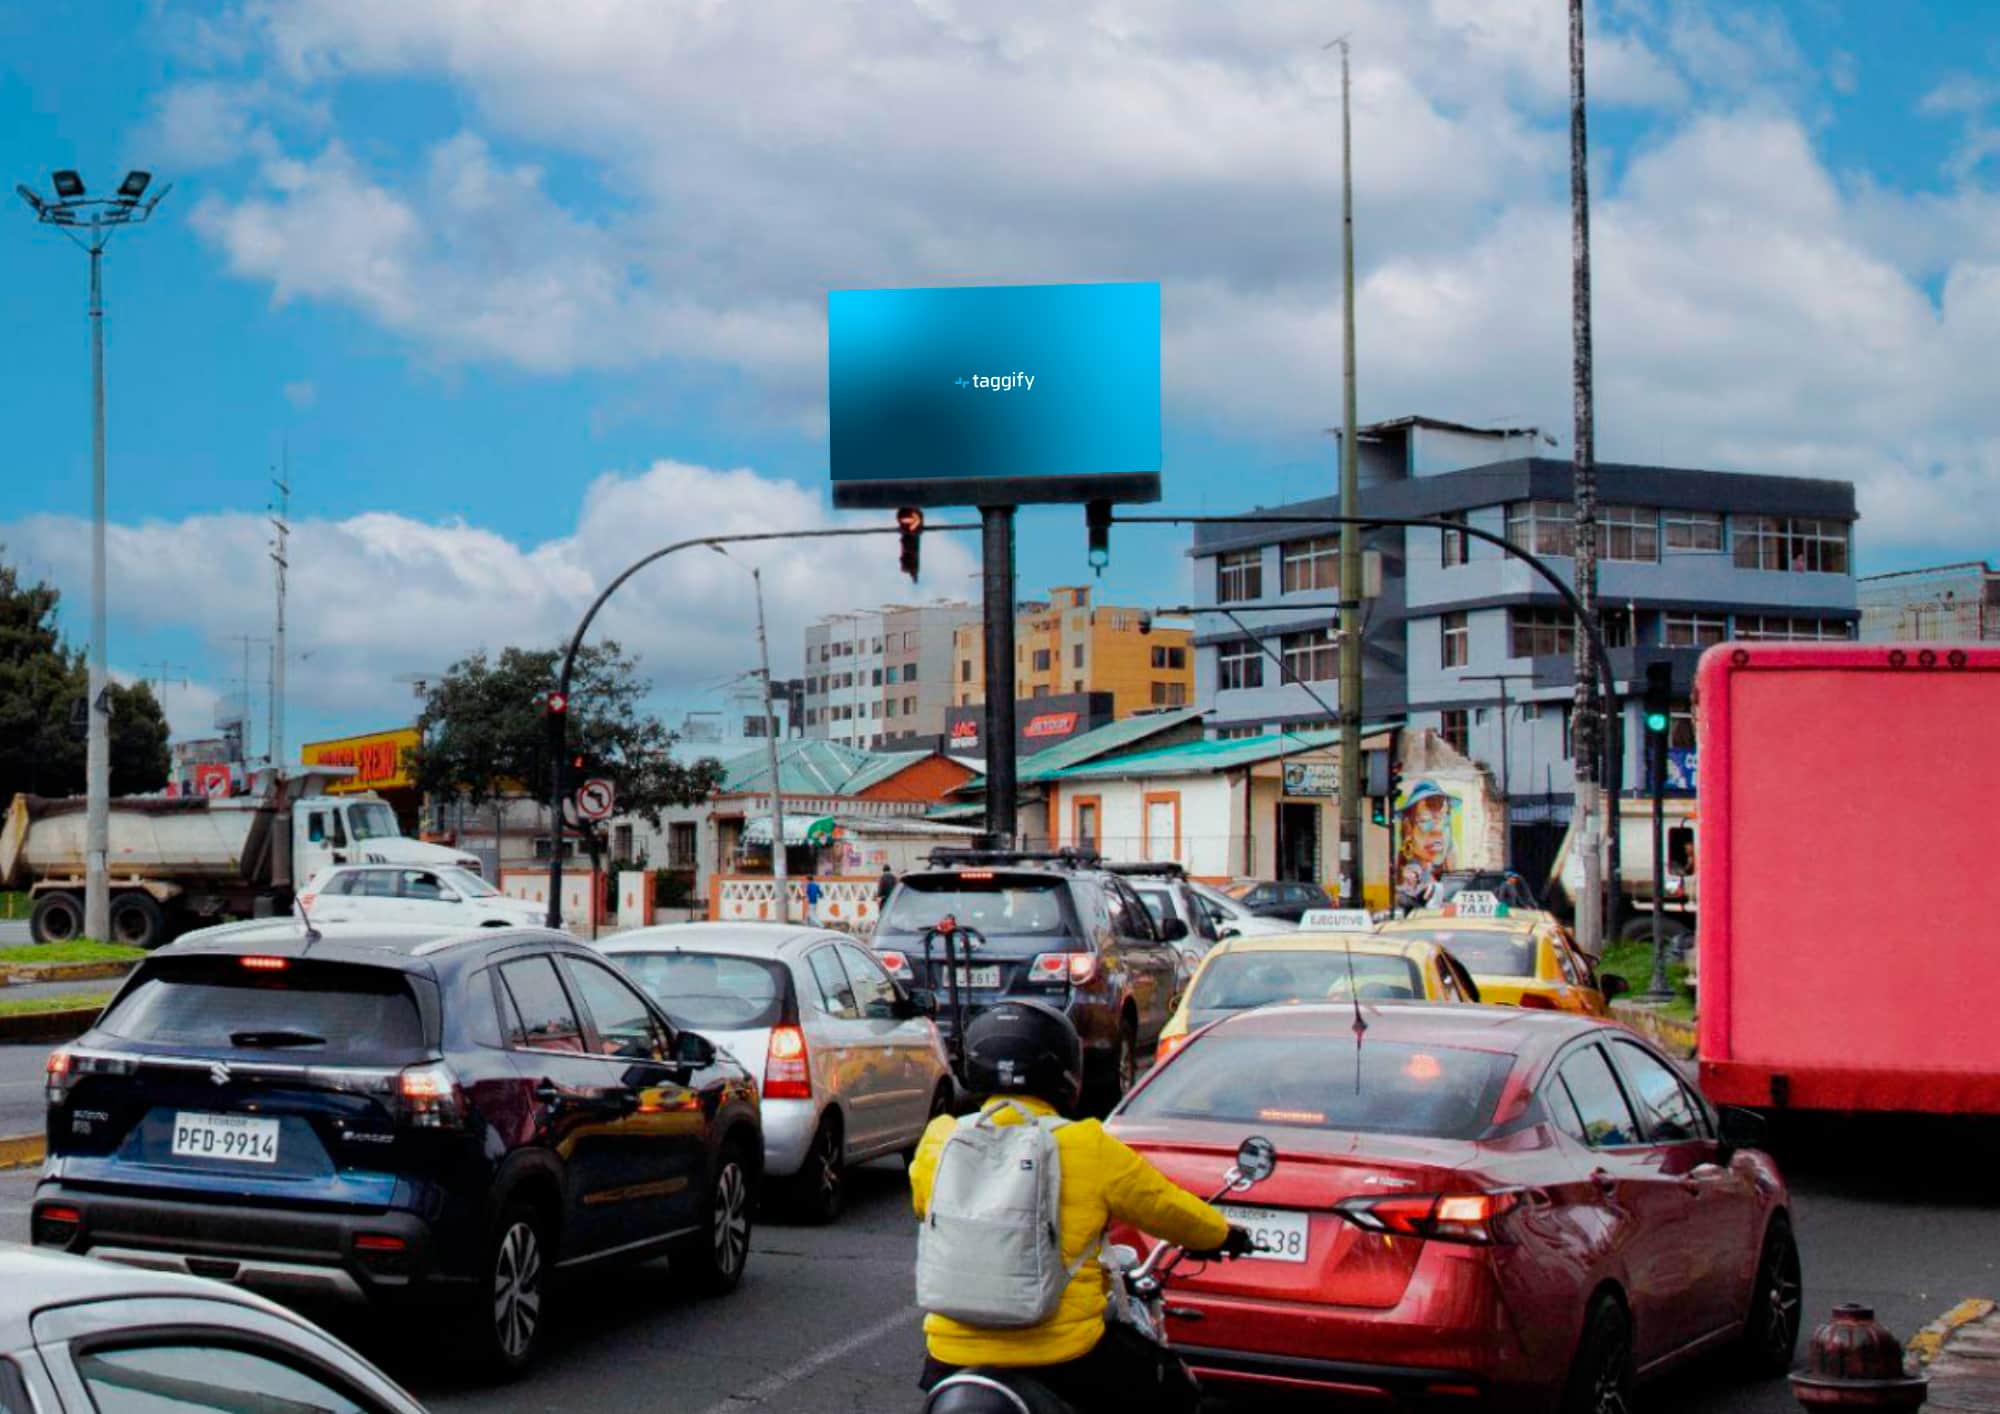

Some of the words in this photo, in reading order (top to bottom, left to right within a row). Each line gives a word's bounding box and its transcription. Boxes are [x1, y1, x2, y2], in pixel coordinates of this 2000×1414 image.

[972, 371, 1035, 391] taggify
[951, 719, 977, 737] JAC
[1461, 893, 1491, 902] TAXI
[1460, 903, 1493, 915] TAXI
[1310, 914, 1364, 927] EJECUTIVO
[176, 1127, 273, 1157] PFD-9914
